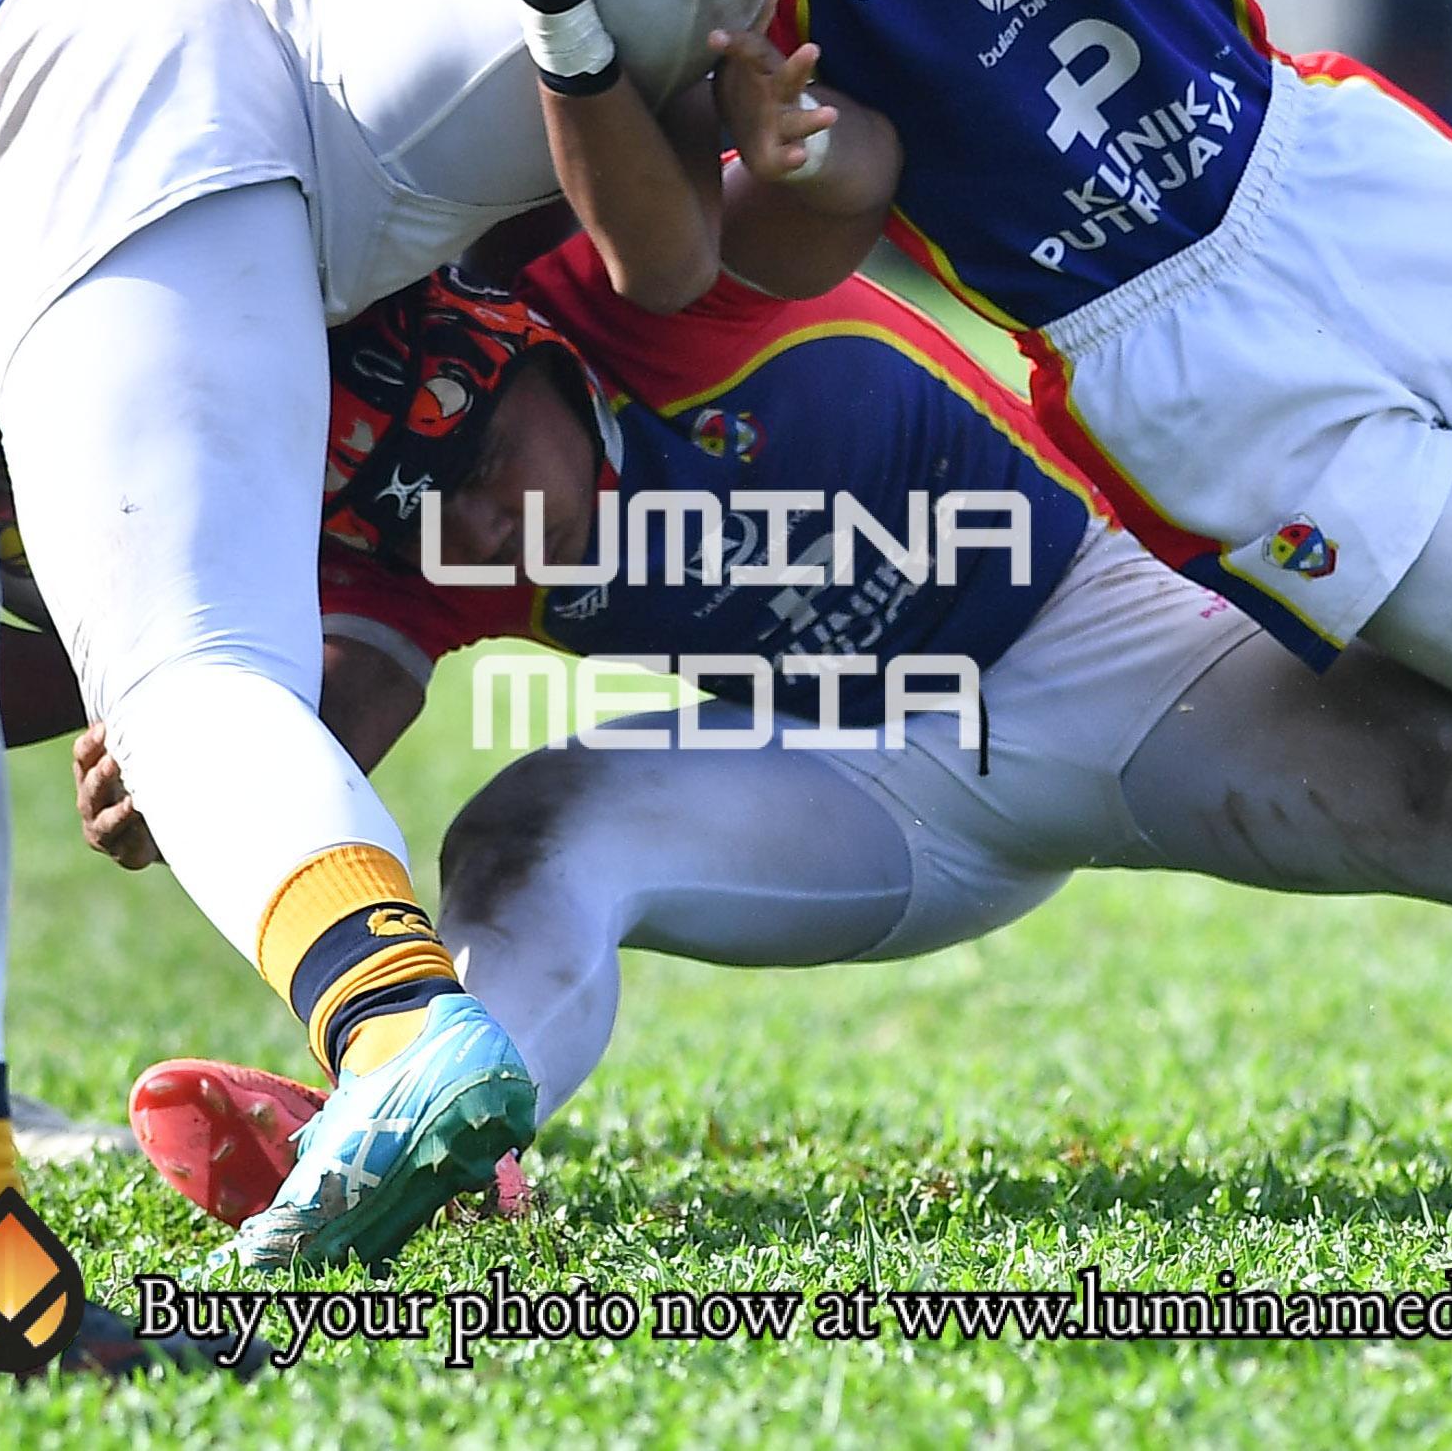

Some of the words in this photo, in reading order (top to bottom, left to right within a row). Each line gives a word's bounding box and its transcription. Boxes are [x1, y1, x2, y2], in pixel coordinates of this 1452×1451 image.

[977, 17, 1024, 68] bulan
[1029, 71, 1241, 274] PUTRIJAYA
[1063, 79, 1212, 215] KLINIK
